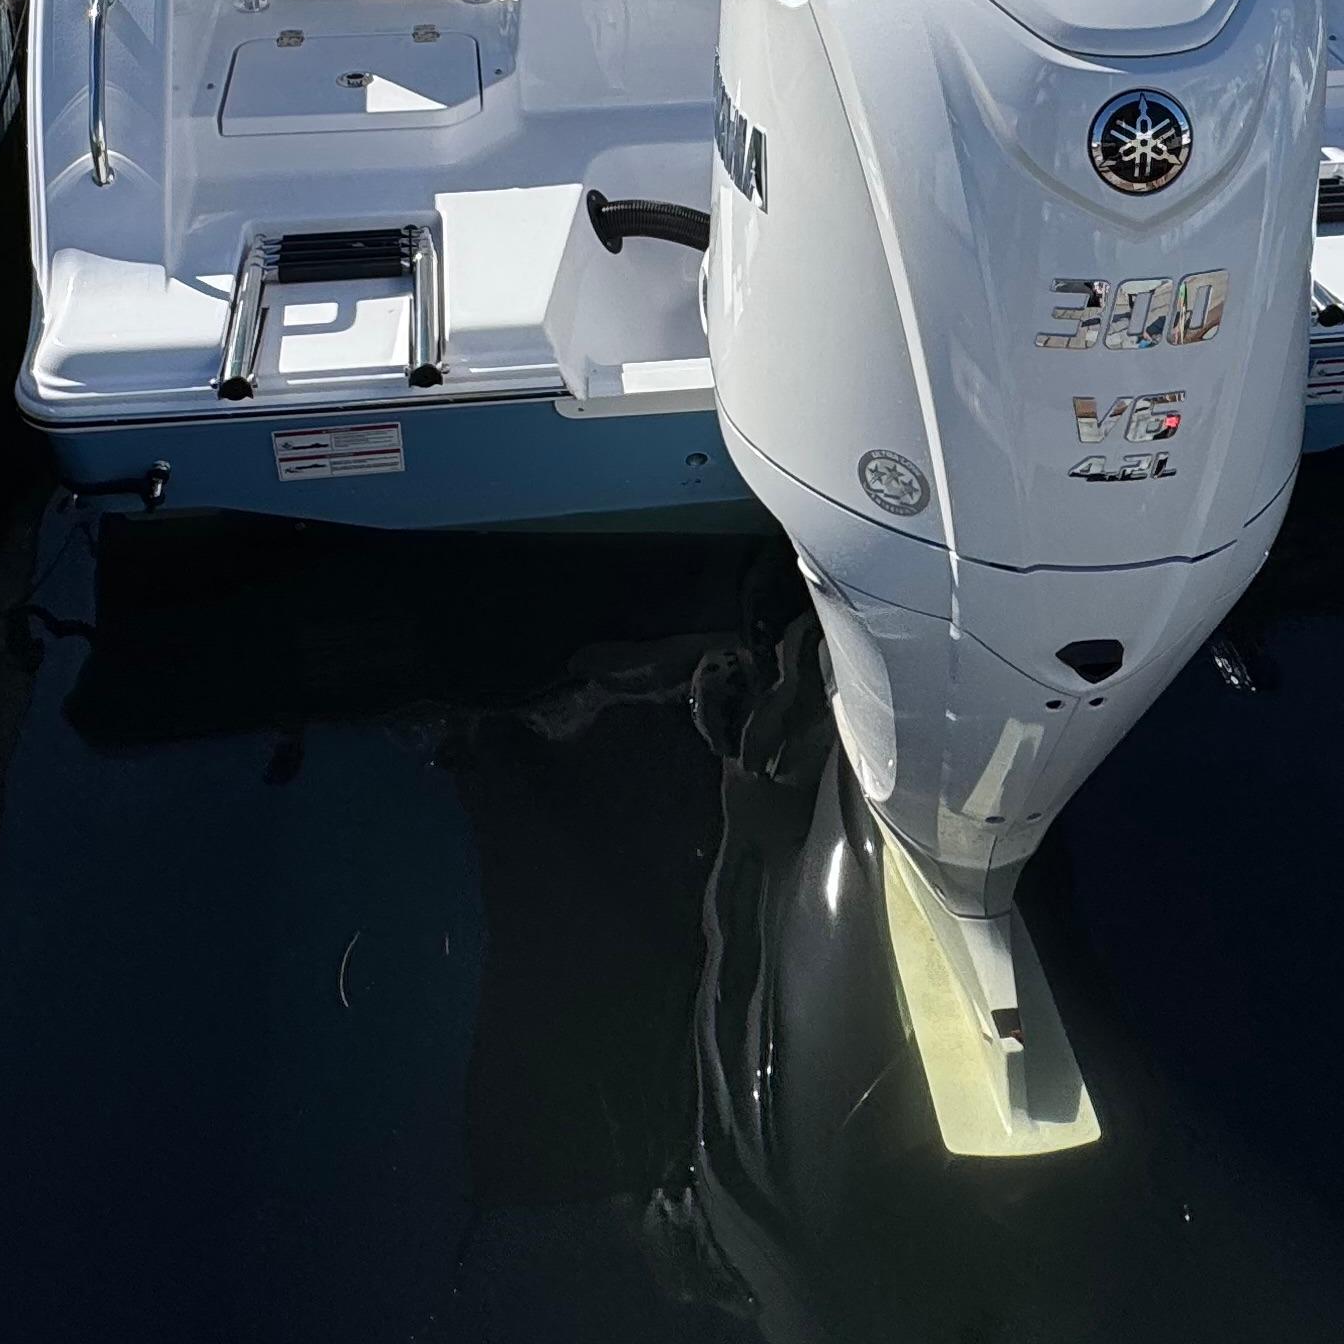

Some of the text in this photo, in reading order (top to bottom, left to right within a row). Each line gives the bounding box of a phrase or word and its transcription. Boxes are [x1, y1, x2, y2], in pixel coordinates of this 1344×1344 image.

[1035, 268, 1231, 350] 300
[1072, 390, 1187, 444] V6
[1068, 451, 1179, 482] 4.2L
